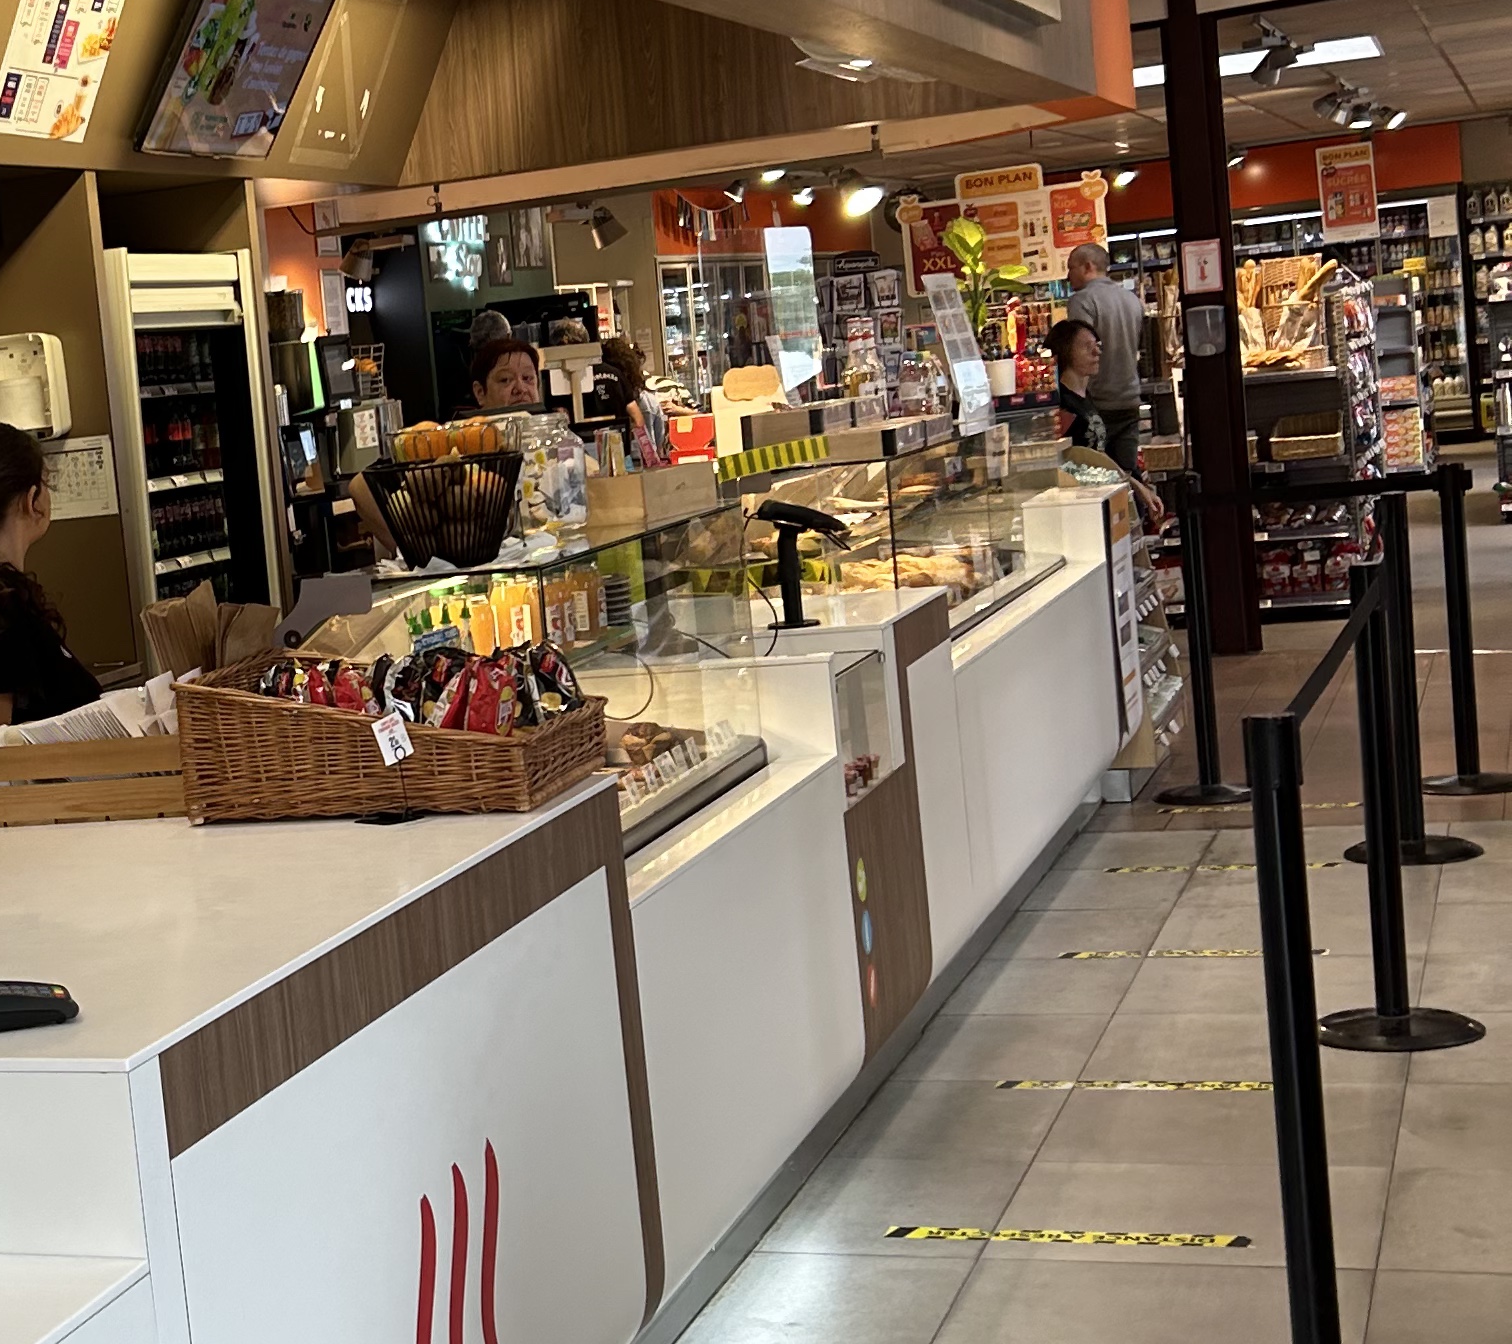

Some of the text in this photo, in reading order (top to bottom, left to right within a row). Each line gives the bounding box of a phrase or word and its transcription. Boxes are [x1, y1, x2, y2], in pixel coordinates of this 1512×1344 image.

[964, 171, 1033, 190] BON PLAN
[922, 256, 957, 273] XXL
